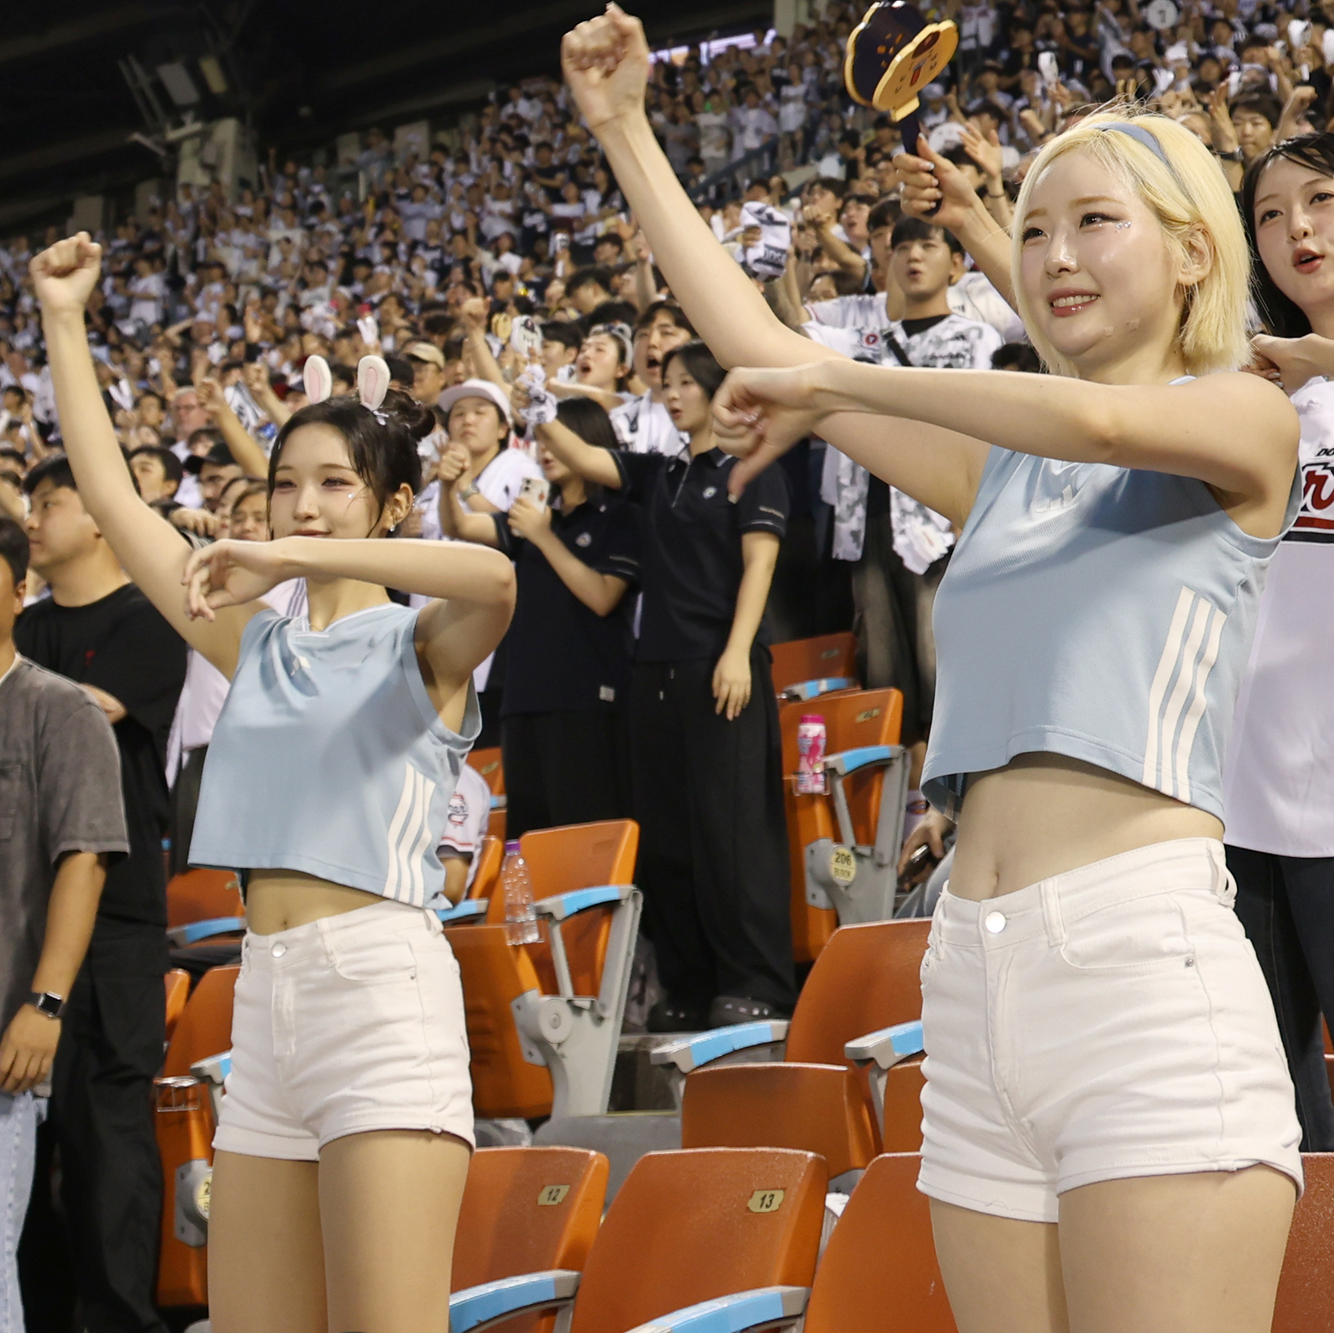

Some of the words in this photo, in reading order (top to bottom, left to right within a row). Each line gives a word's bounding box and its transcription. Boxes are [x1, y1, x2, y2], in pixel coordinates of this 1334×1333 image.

[835, 851, 852, 866] 206
[547, 1188, 561, 1202] 12
[759, 1194, 775, 1209] 13
